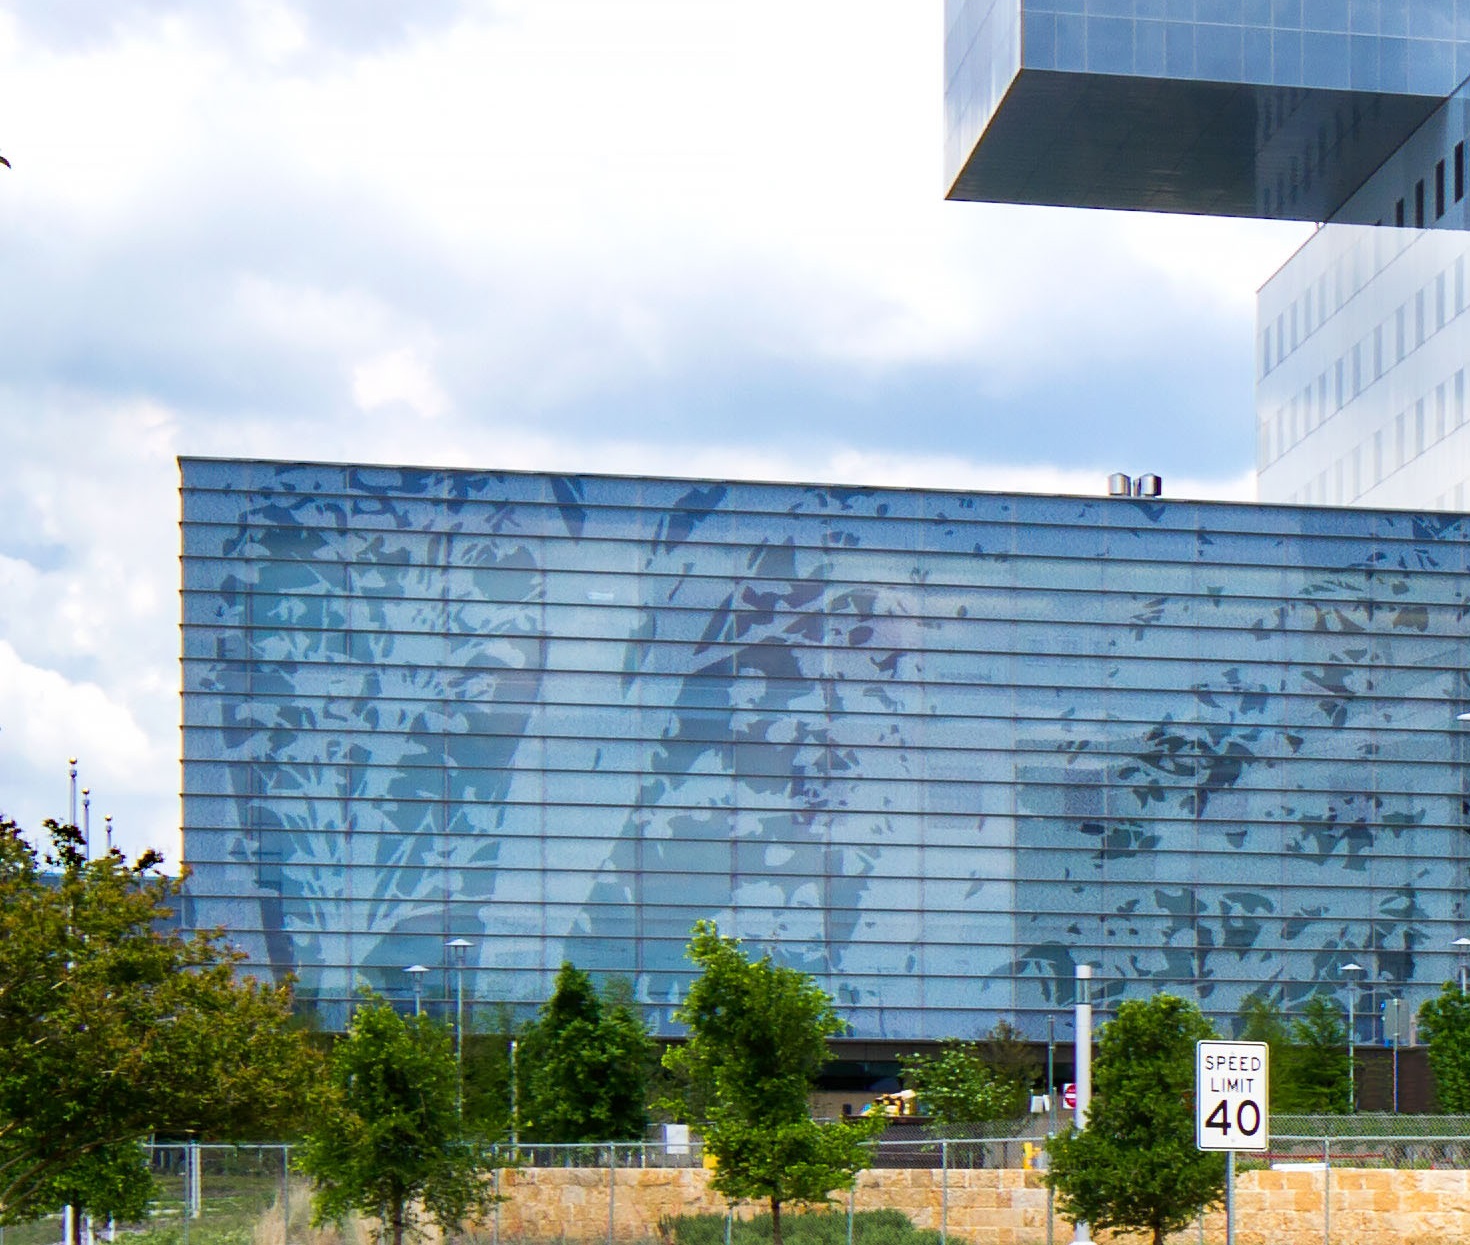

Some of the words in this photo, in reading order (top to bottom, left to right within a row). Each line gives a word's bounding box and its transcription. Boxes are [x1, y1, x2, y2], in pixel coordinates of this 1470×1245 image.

[1205, 1055, 1261, 1072] SPEED
[1211, 1077, 1255, 1093] LIMIT
[1205, 1099, 1261, 1136] 40
